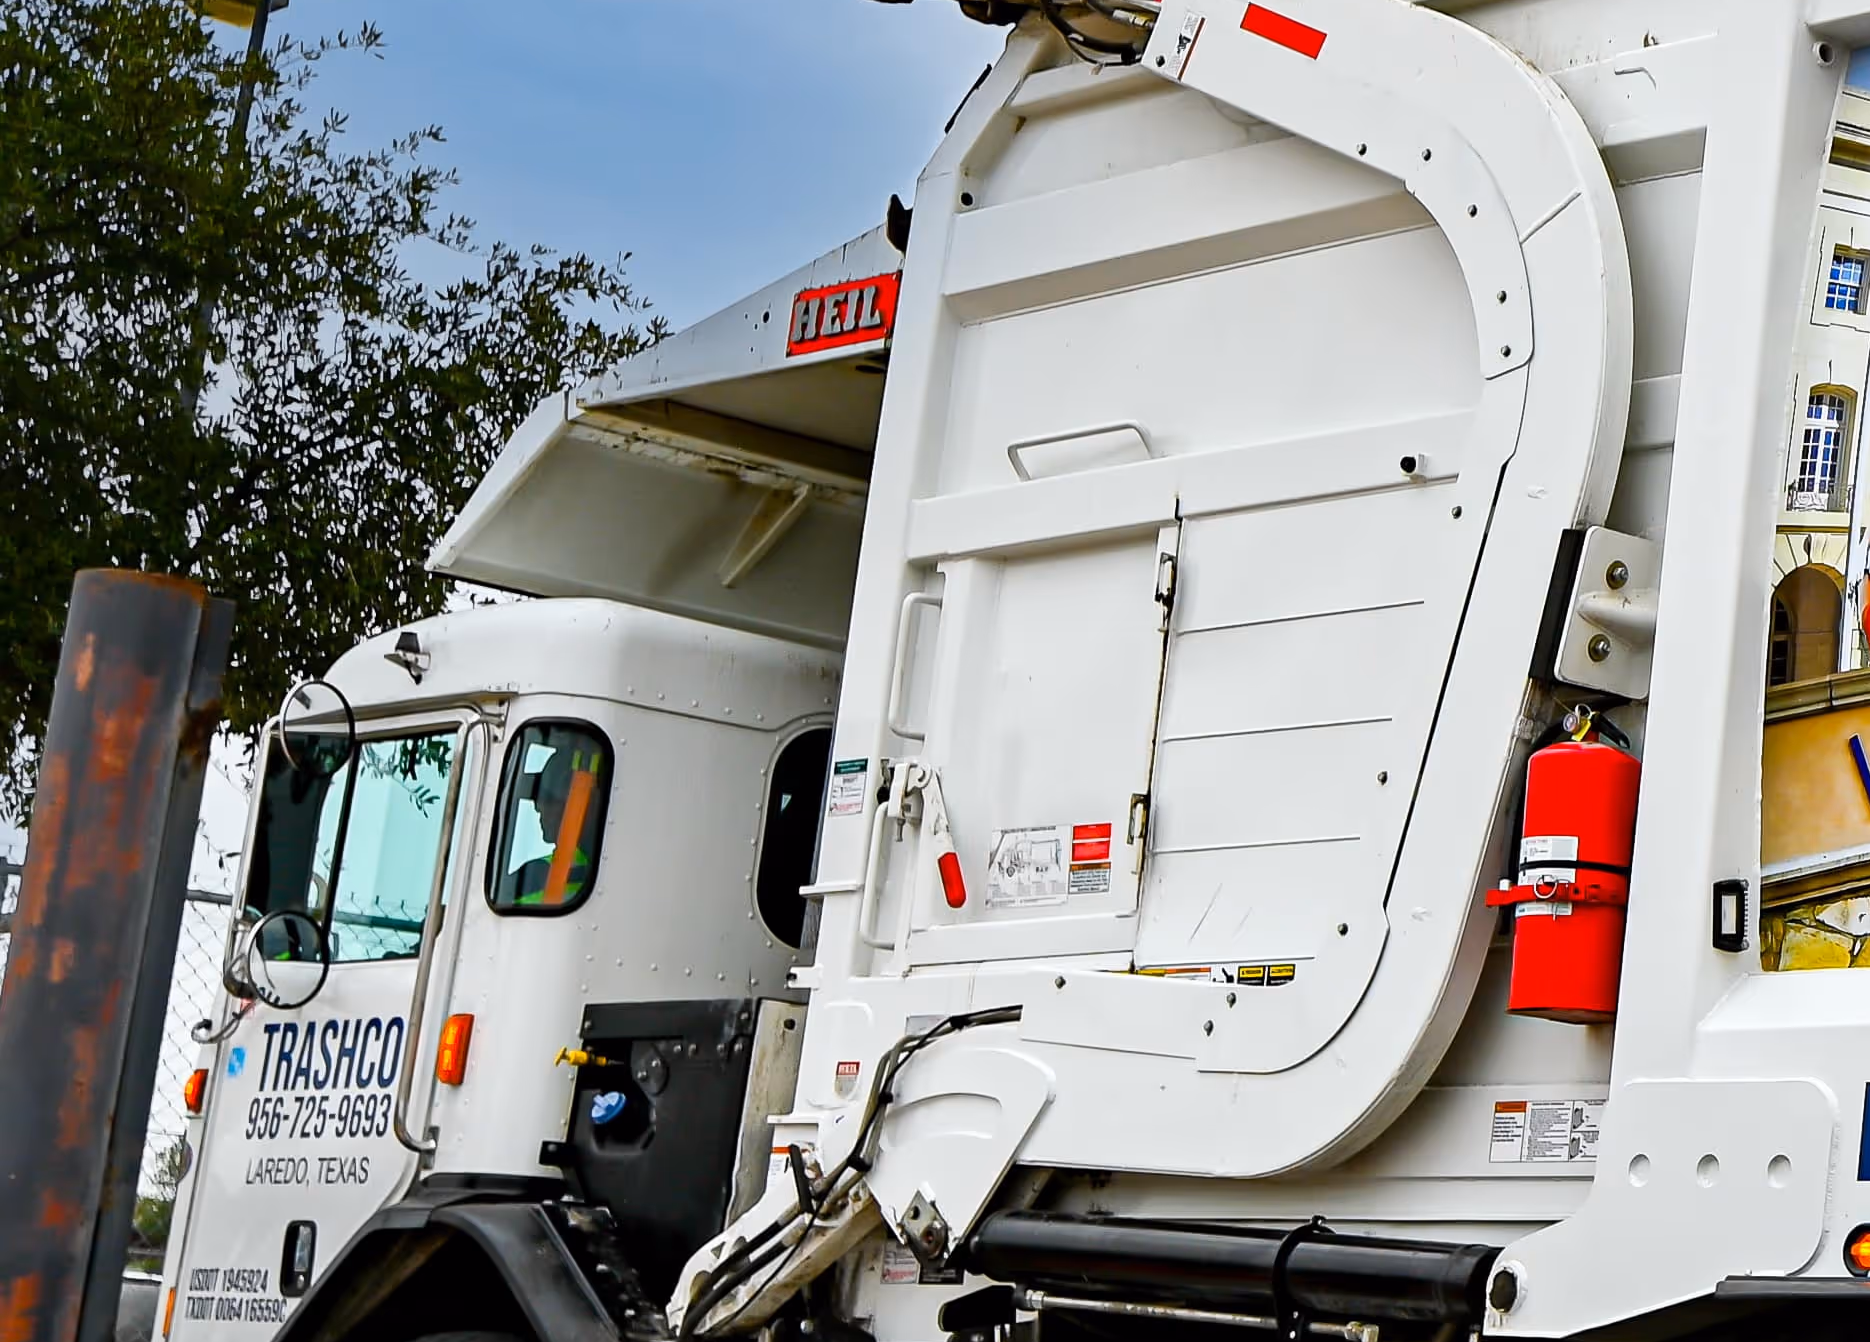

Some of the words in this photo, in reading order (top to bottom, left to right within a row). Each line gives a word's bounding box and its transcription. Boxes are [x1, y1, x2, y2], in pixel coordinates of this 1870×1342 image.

[791, 286, 881, 342] HEIL
[258, 1016, 405, 1092] TRASHCO
[245, 1094, 391, 1139] 956-725-9693
[246, 1157, 310, 1187] LAREDO,
[317, 1157, 370, 1184] TEXAS
